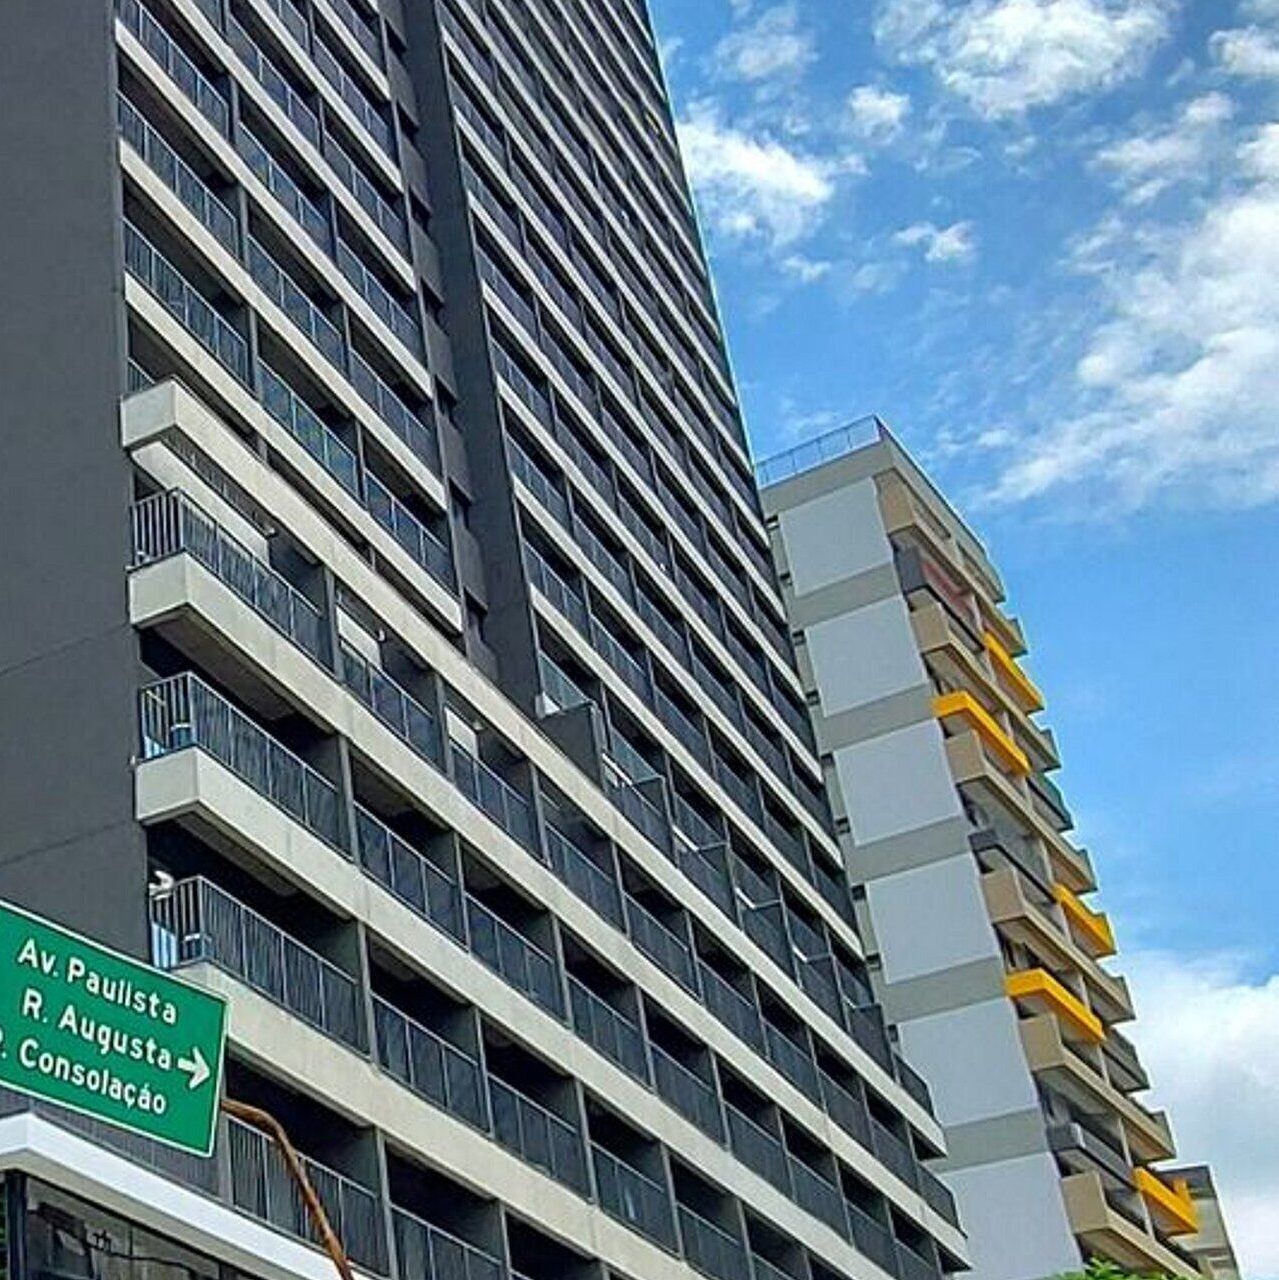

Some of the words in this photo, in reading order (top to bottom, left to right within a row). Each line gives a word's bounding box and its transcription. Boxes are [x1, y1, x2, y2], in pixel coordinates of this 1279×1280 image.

[17, 938, 58, 977] Av.
[66, 956, 177, 1025] Paulista
[22, 987, 48, 1023] R.
[58, 1005, 172, 1071] Augusta
